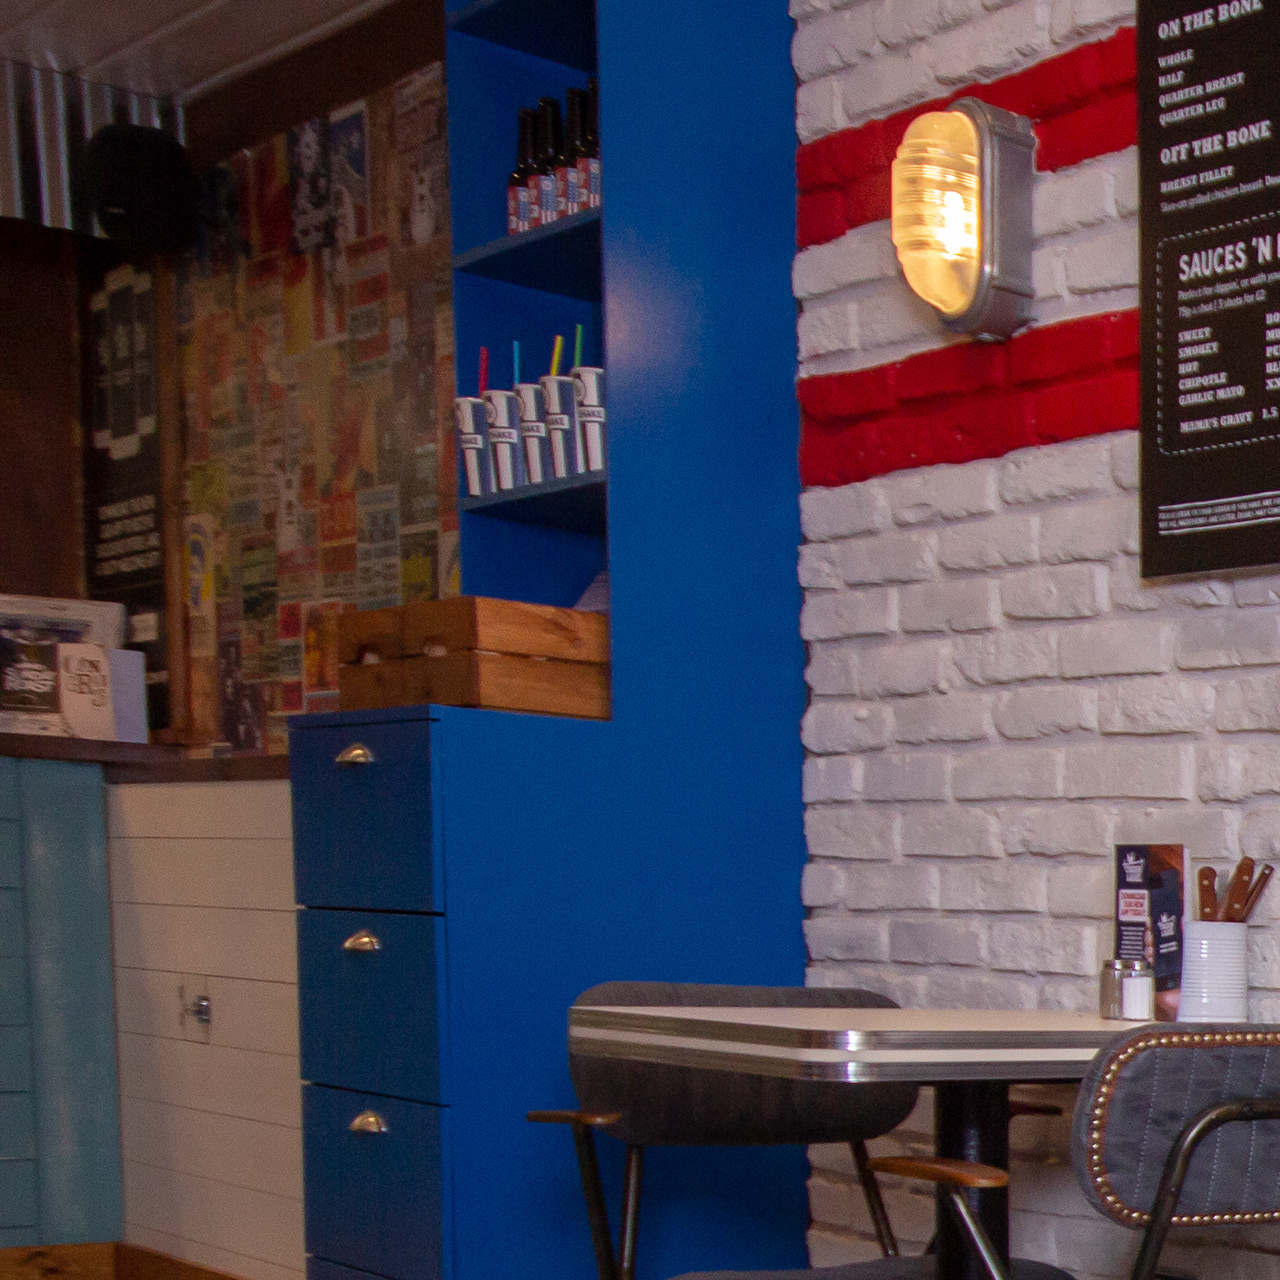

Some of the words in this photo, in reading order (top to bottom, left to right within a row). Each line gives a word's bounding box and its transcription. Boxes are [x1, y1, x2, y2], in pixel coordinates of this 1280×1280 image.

[1158, 18, 1180, 39] ON
[1183, 8, 1214, 32] THE
[1218, 0, 1262, 22] BONE
[1161, 143, 1190, 164] OFF
[1192, 134, 1223, 156] THE
[1227, 120, 1271, 147] BONE
[1179, 242, 1247, 281] SAUCES
